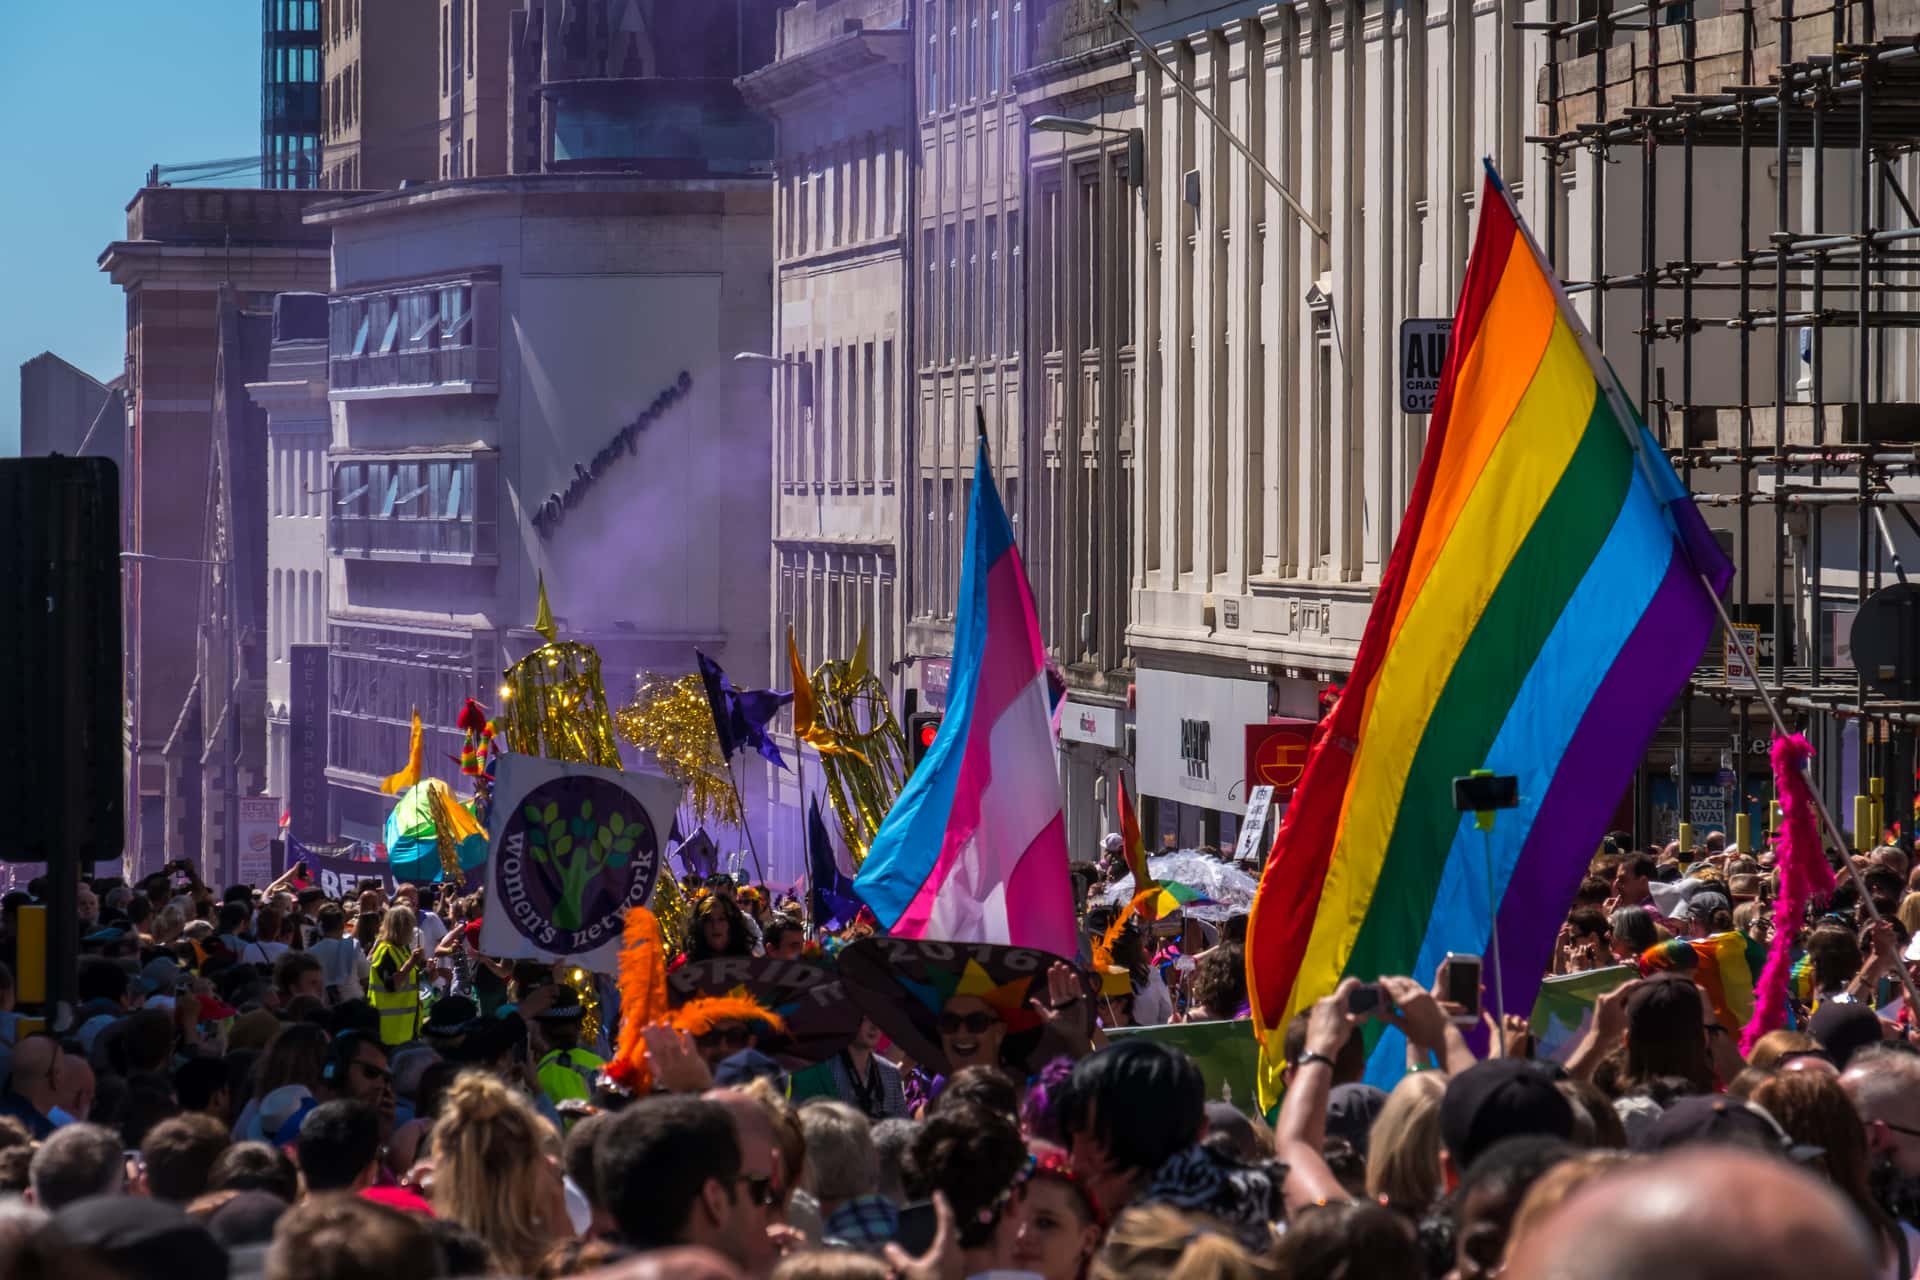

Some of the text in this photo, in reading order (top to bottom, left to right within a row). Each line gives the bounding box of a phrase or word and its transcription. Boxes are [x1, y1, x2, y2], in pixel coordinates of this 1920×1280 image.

[503, 832, 653, 948] women's network
[878, 938, 1040, 972] 2016
